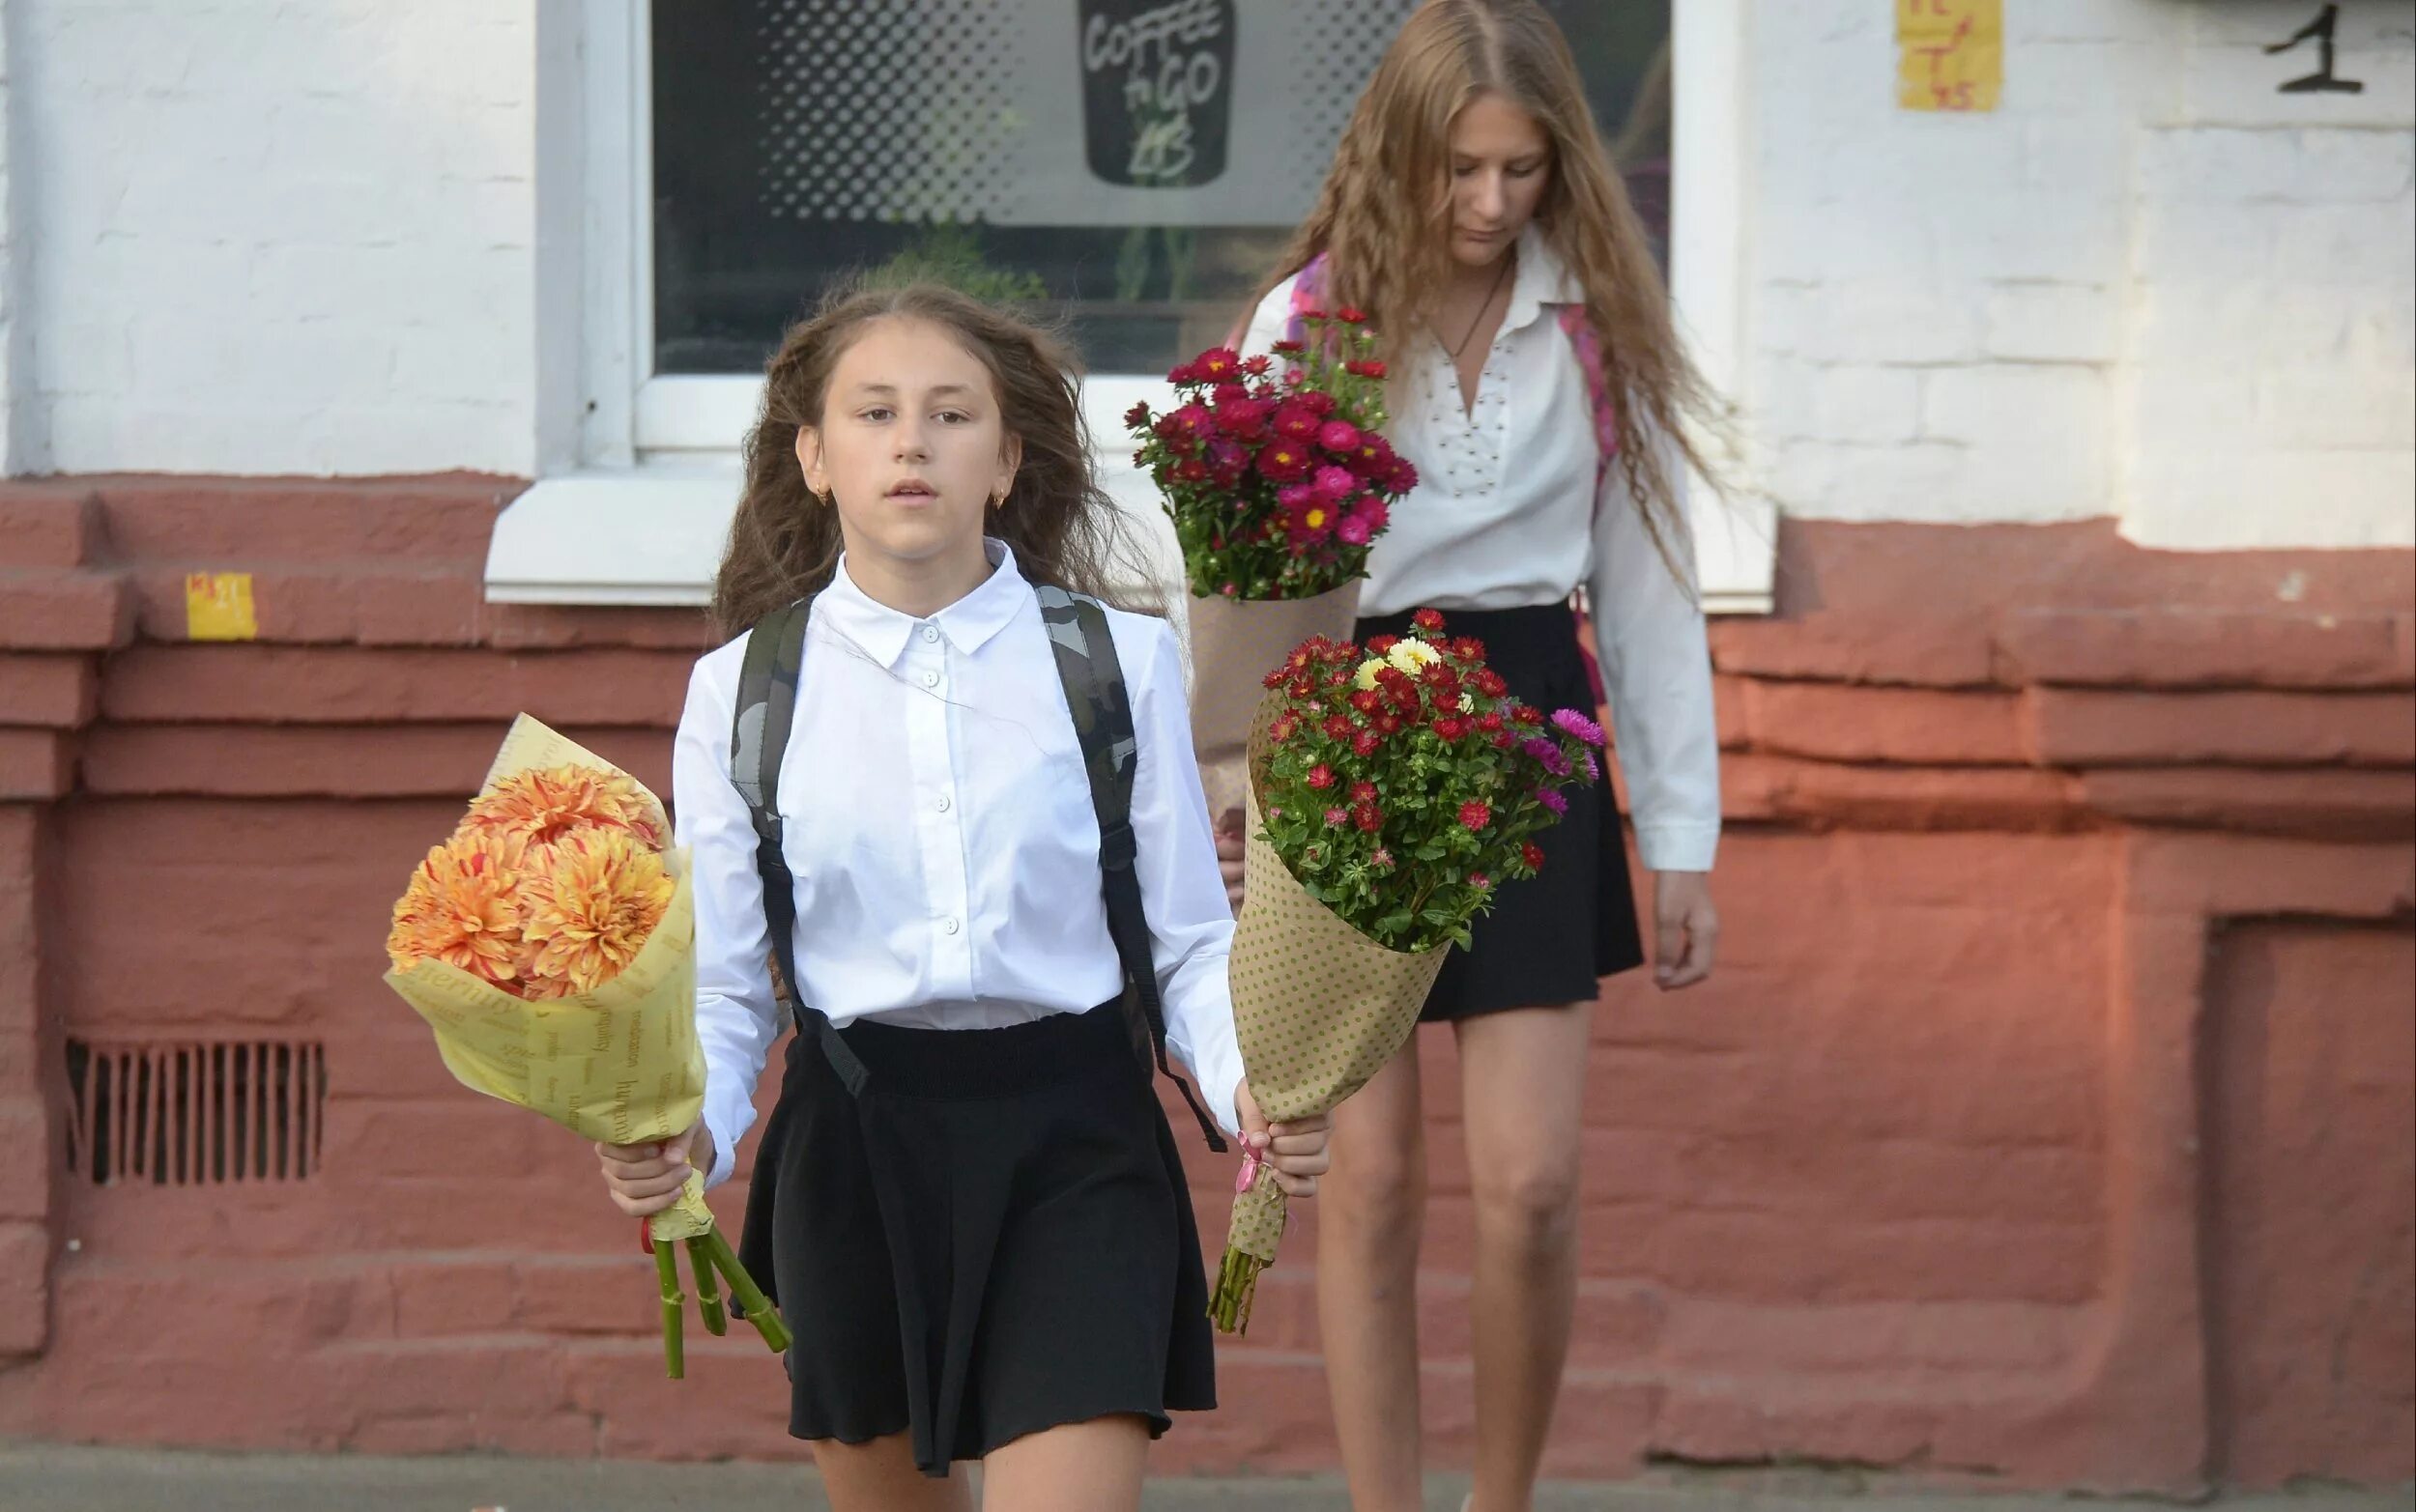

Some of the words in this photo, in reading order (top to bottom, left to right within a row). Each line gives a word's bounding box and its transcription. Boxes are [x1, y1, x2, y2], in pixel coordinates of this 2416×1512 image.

[1085, 0, 1222, 72] COFFEE
[2262, 4, 2365, 93] 1
[1158, 50, 1221, 113] GO
